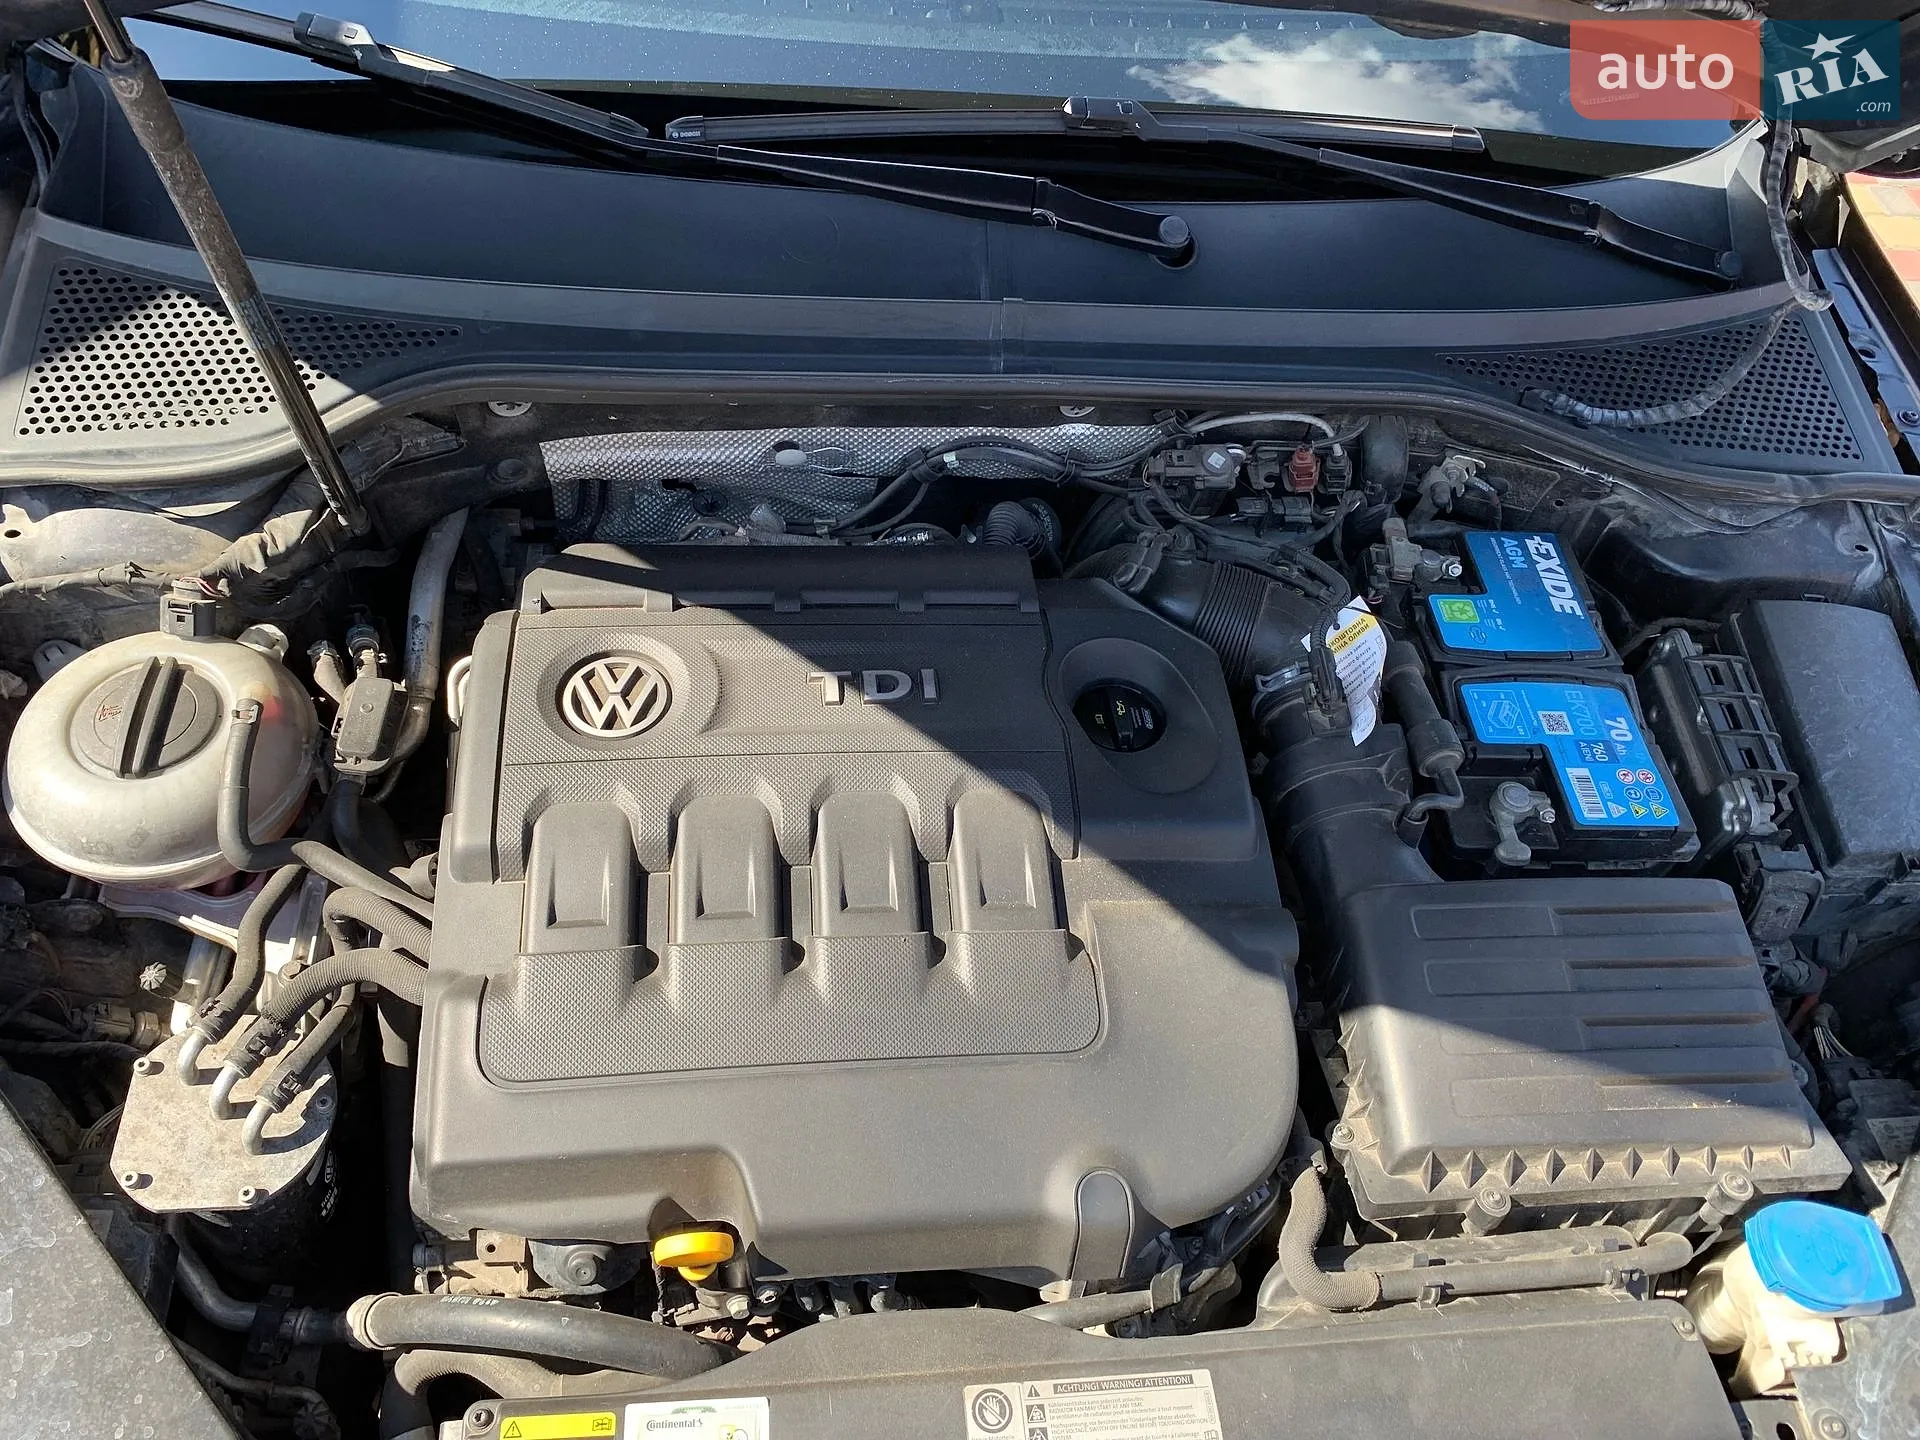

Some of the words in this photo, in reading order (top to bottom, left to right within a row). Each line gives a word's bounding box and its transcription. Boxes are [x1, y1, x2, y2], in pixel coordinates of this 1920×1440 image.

[1501, 537, 1528, 569] AGM
[1525, 536, 1583, 617] EXIDE
[565, 658, 665, 736] VW
[808, 668, 940, 706] TDI
[1564, 690, 1598, 736] EK700
[1604, 717, 1633, 742] 70
[1591, 742, 1609, 762] 760
[1615, 743, 1627, 756] Ah
[1057, 1381, 1100, 1393] ACHTUNG!
[1101, 1378, 1143, 1390] WARNING!
[1144, 1375, 1192, 1388] ATTENTION!
[646, 1420, 696, 1431] Continental
